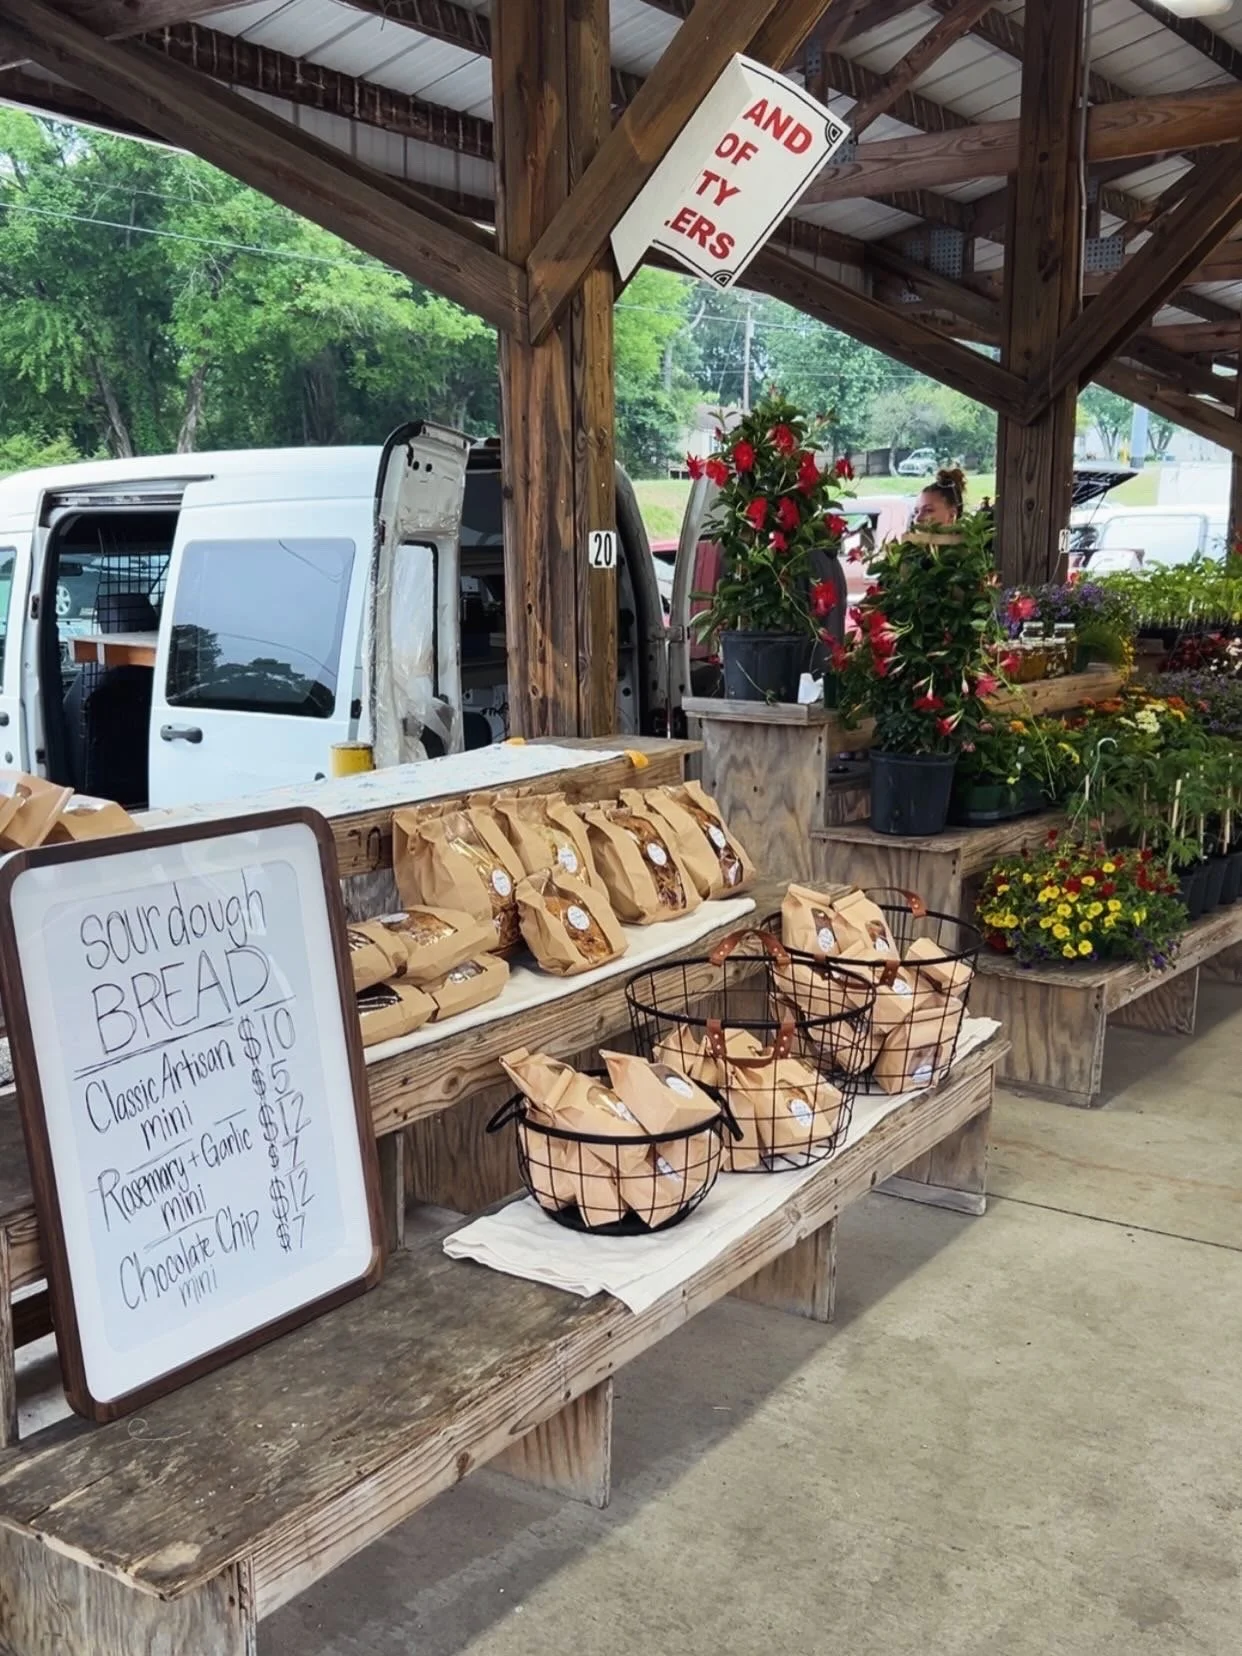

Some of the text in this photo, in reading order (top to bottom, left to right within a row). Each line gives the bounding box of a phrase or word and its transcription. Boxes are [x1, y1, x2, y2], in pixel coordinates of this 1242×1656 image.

[714, 133, 759, 166] OF
[742, 98, 813, 154] AND
[664, 207, 735, 260] ERS
[695, 170, 741, 206] TY
[594, 533, 612, 566] 20
[92, 945, 270, 1054] BREAD
[85, 1008, 296, 1133] Classic Artisan $10
[140, 1059, 291, 1151] mini $5
[89, 1155, 191, 1232] Rosemary
[200, 1120, 253, 1168] Garlic
[258, 1094, 312, 1143] $12
[162, 1136, 303, 1232] mini $7
[120, 1167, 315, 1310] Chocolate Chip $12
[179, 1213, 306, 1308] mini $7
